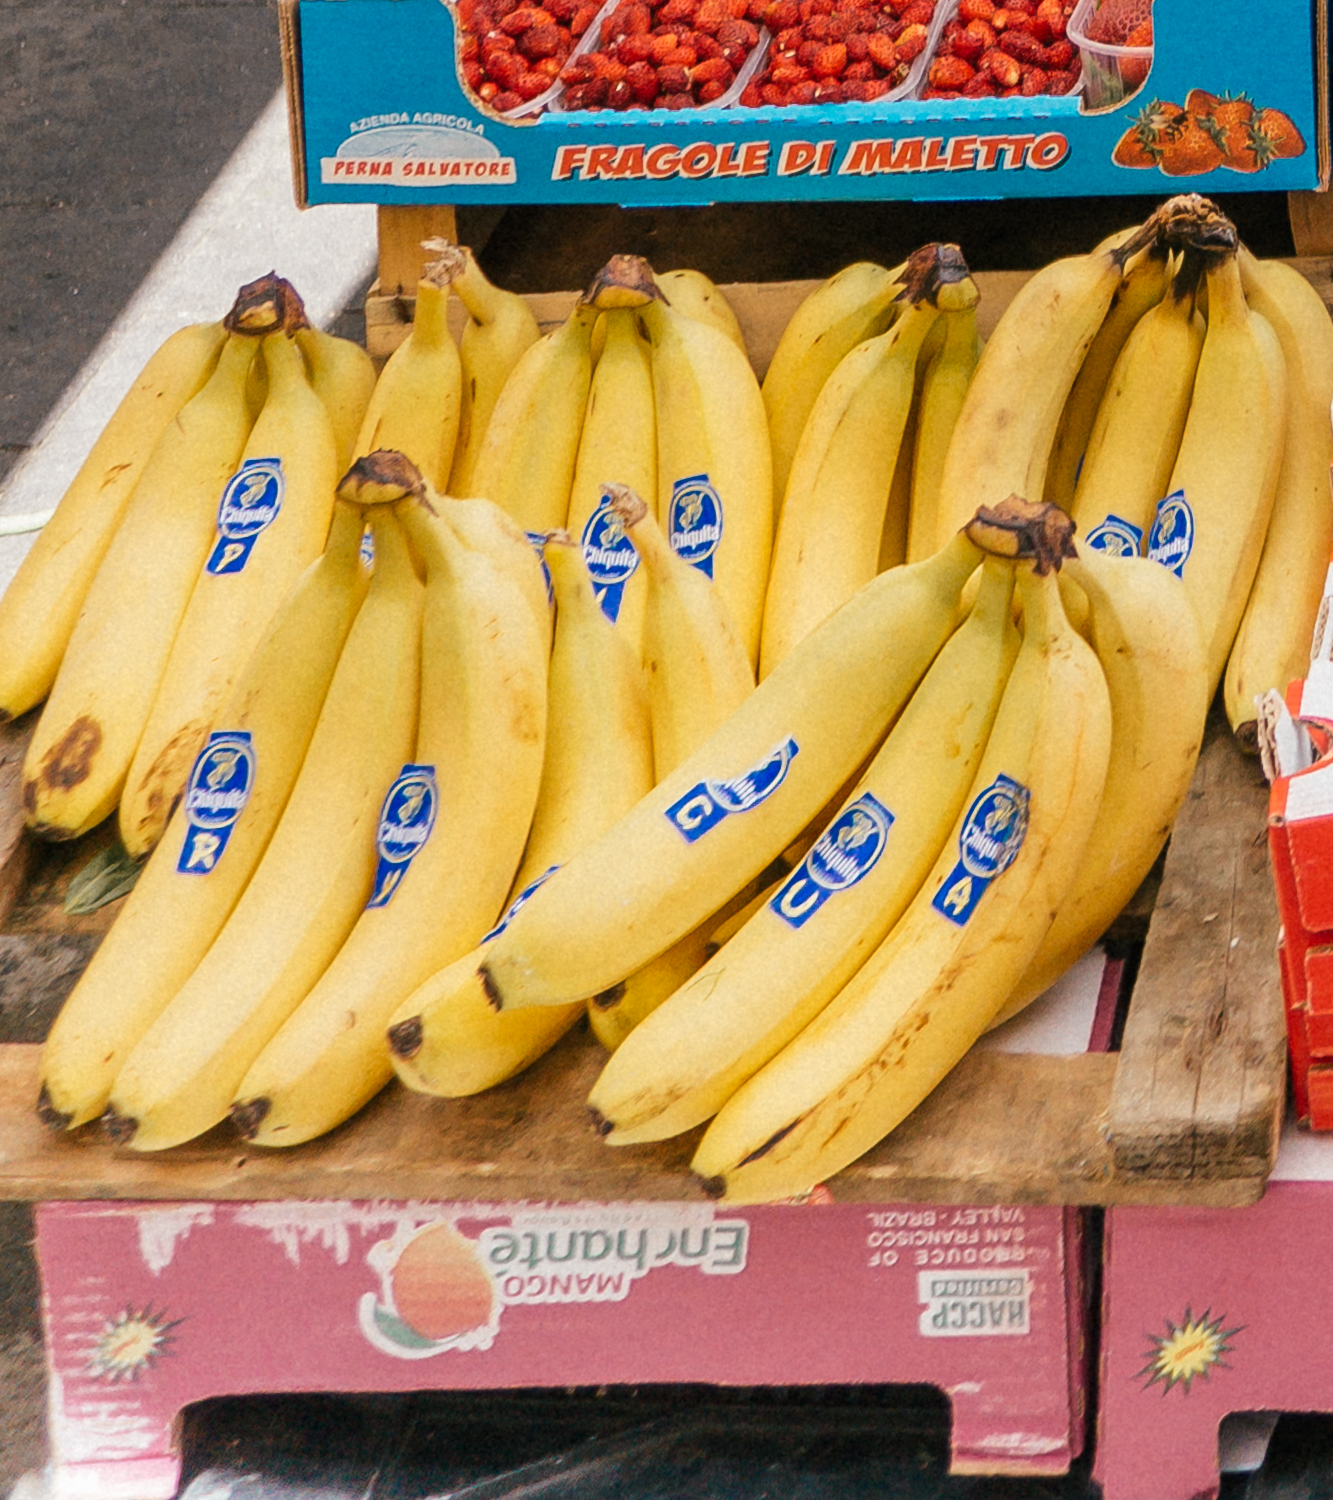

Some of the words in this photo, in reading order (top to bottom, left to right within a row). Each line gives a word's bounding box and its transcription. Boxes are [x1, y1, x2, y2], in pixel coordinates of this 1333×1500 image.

[348, 112, 410, 136] AZIENDA
[412, 111, 486, 136] AGRICOLA
[551, 137, 772, 181] FRAGOLE
[779, 137, 834, 175] DI
[840, 131, 1071, 175] MALETTO
[332, 159, 394, 179] PERNA
[402, 157, 512, 180] SALVATORE
[219, 504, 276, 527] Chiquita
[670, 525, 722, 549] Chiquita
[582, 546, 640, 569] Chiquita
[187, 787, 247, 810] Chiquita
[377, 821, 428, 846] Chiquita
[813, 831, 860, 884] Chiquita
[865, 1210, 938, 1229] BRAZIL
[950, 1205, 1027, 1225] VALLEY
[864, 1228, 981, 1248] FRANCISCO
[985, 1226, 1027, 1244] SAN
[866, 1250, 900, 1268] OF
[913, 1245, 1027, 1266] PRODUCE
[504, 1272, 625, 1299] MANGO
[931, 1279, 1025, 1298] Certified
[932, 1300, 1026, 1330] HACCP
